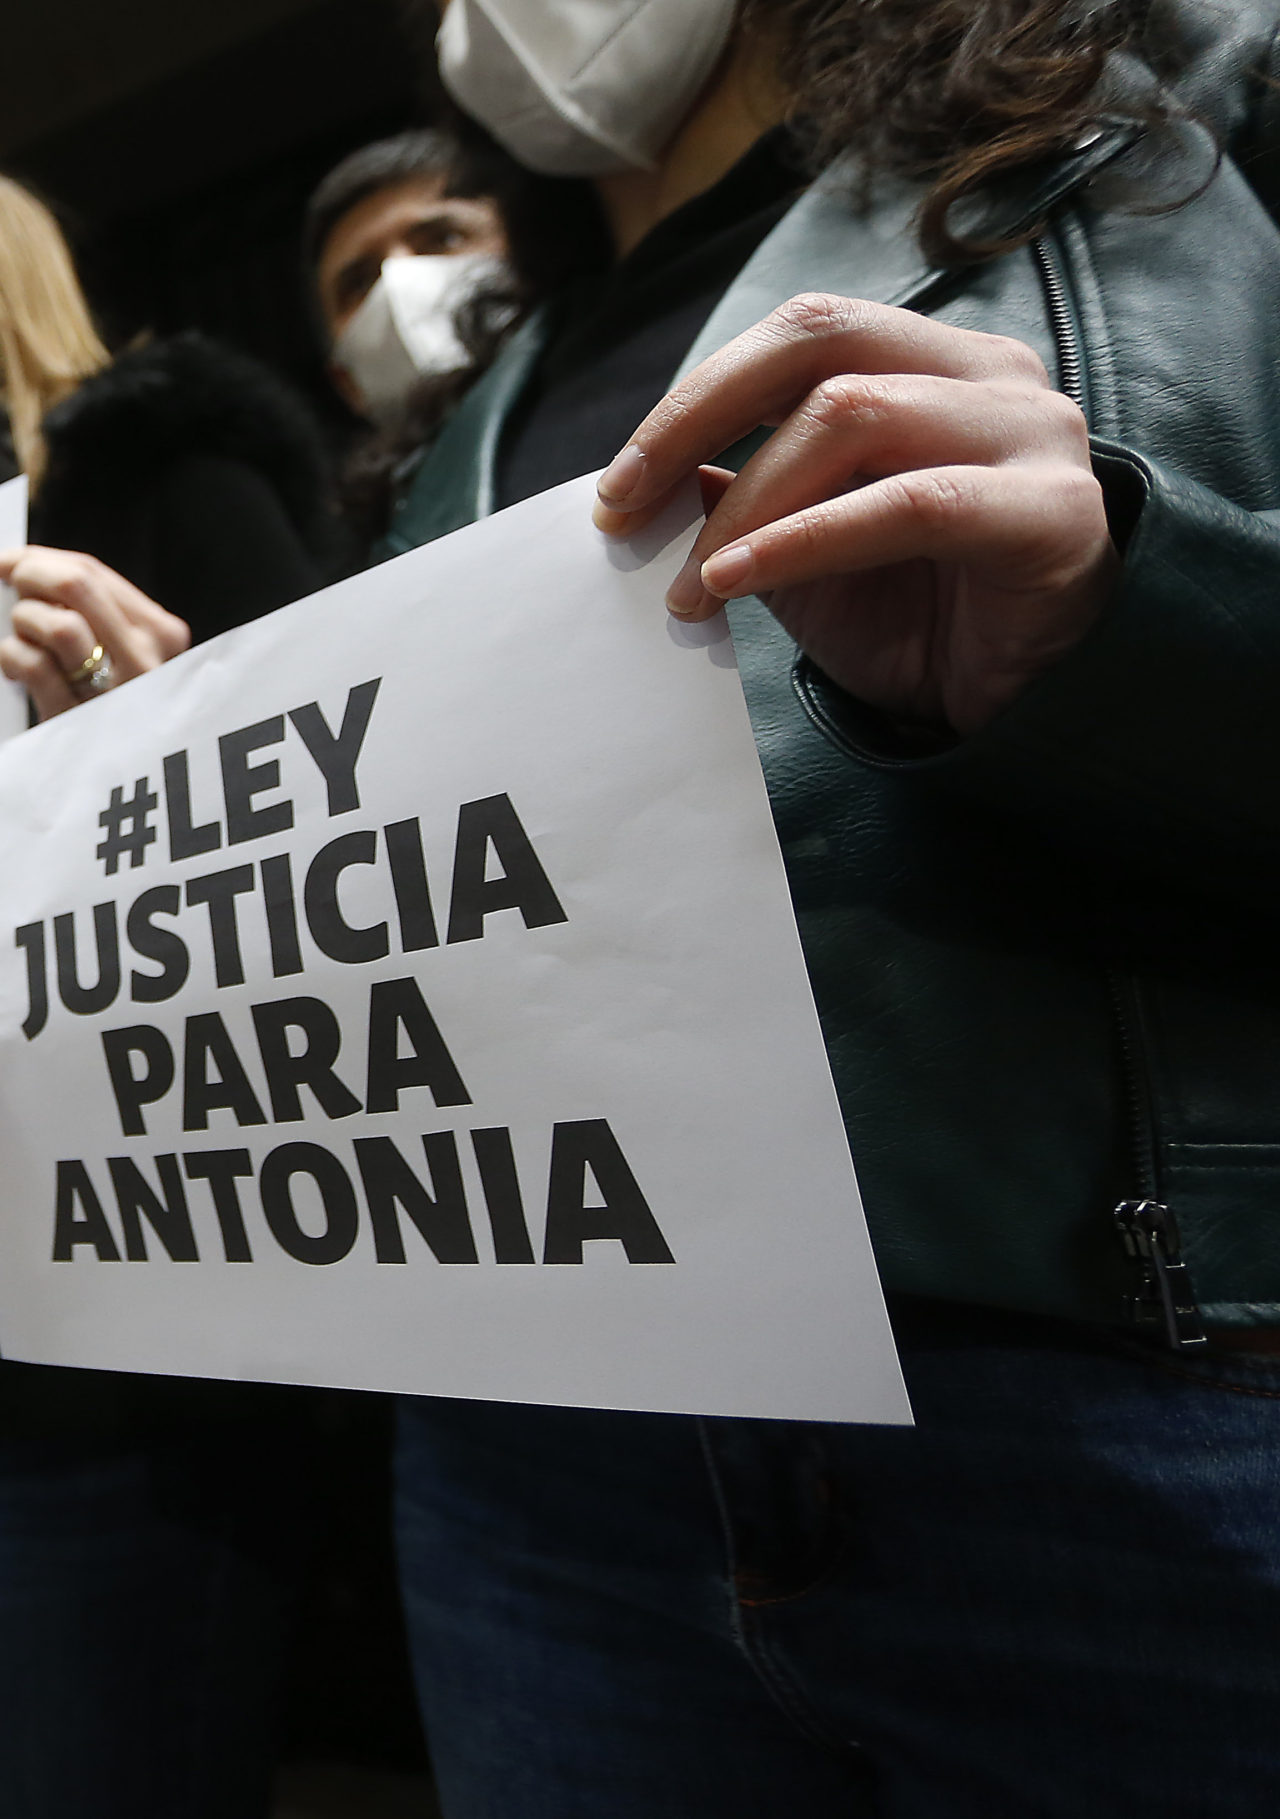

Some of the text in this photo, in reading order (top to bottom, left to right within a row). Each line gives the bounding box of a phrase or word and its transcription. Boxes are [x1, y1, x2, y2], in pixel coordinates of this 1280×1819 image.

[96, 676, 382, 876] #LEY
[14, 792, 568, 1041] JUSTICIA
[100, 975, 473, 1137] PARA
[51, 1117, 676, 1266] ANTONIA
